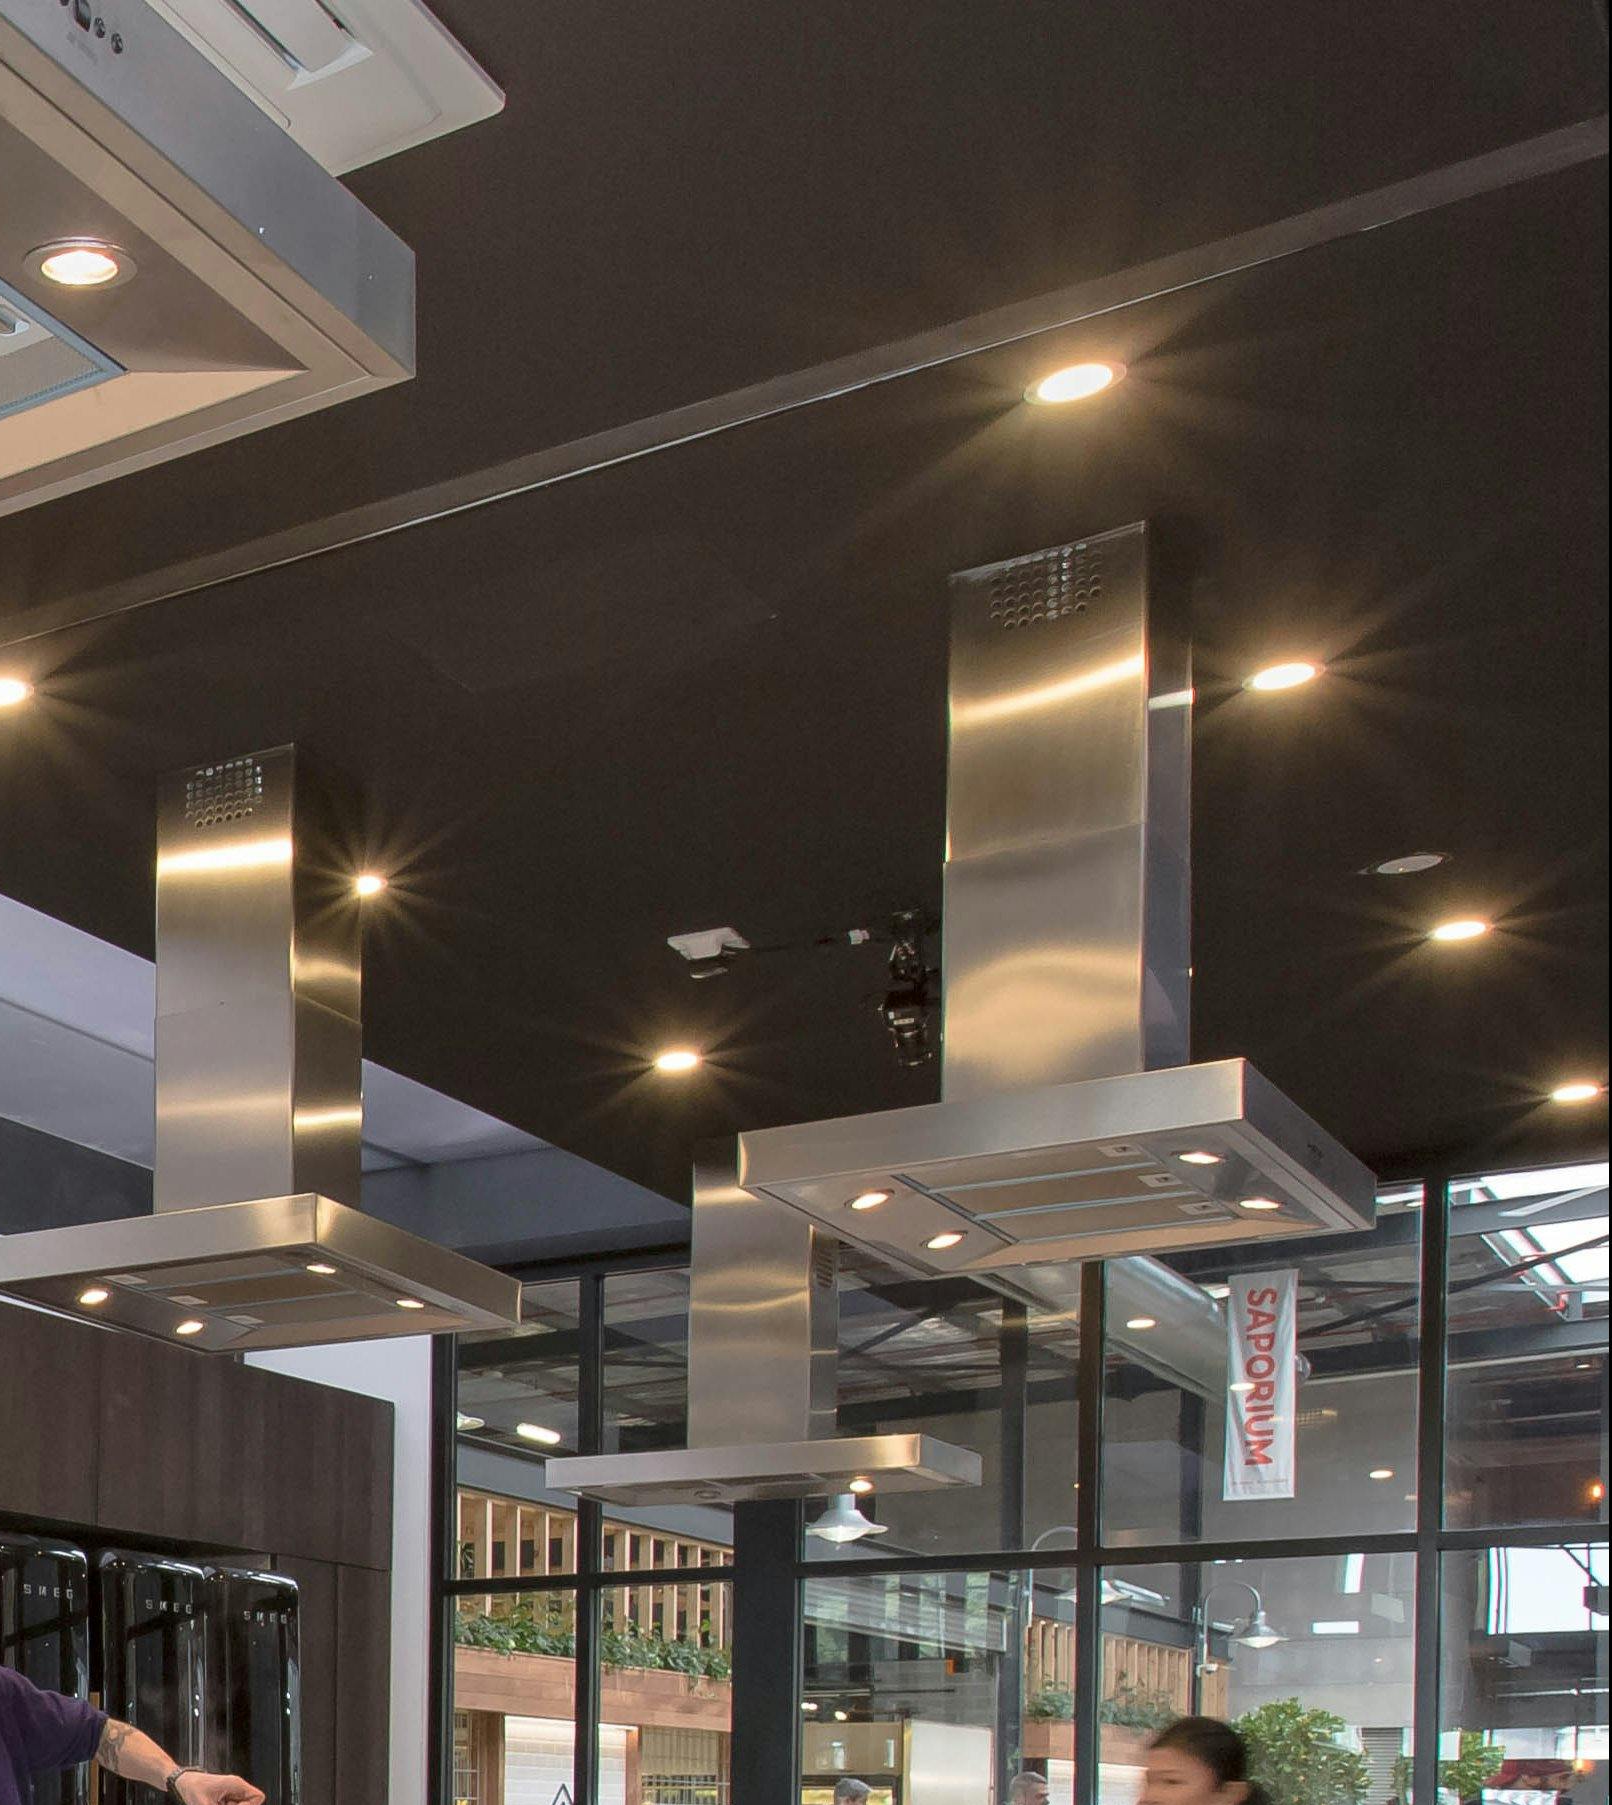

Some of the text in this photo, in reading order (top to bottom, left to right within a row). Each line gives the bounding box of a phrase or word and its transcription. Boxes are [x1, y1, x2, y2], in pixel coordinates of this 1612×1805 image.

[1244, 1287, 1278, 1466] SAPORIUM
[23, 1584, 74, 1599] SMEG
[145, 1599, 192, 1614] SMEG
[243, 1610, 288, 1624] SMEG
